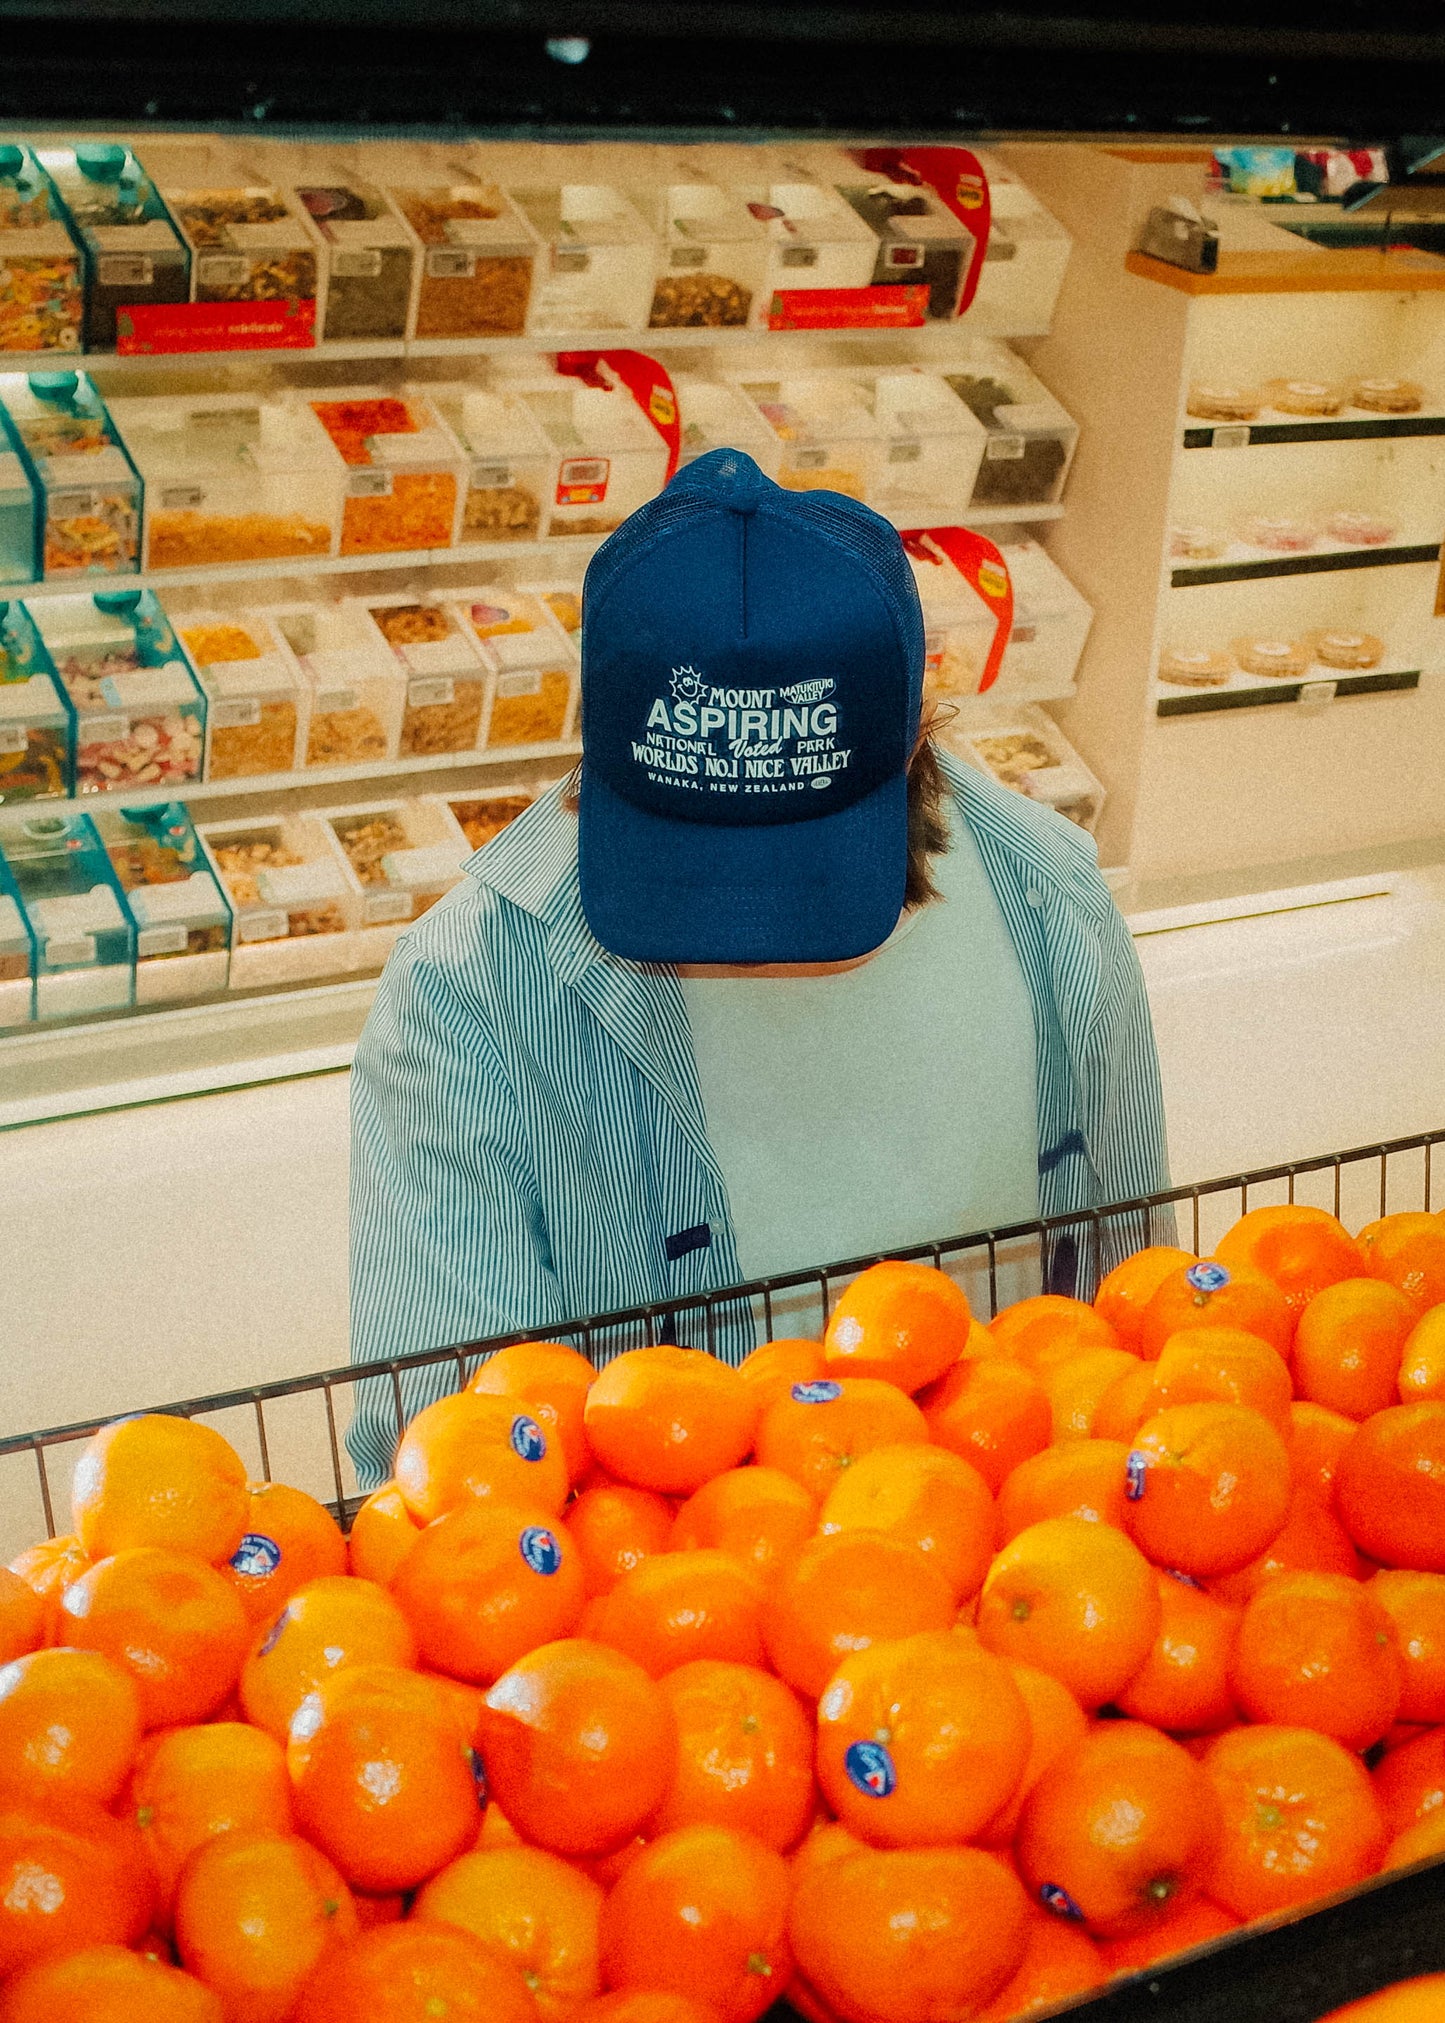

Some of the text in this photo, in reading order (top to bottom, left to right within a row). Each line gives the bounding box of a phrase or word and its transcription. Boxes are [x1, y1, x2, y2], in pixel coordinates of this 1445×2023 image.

[708, 687, 776, 709] MOUNT
[791, 690, 825, 704] VALLEY
[646, 698, 838, 740] ASPIRING
[646, 732, 836, 758] NATIONAL Voted PARK
[630, 741, 852, 779] WORLDS NO.1 NICE VALLEY
[647, 772, 704, 792] WANAKA,
[710, 782, 739, 793] NEW
[744, 781, 805, 793] ZEALAND
